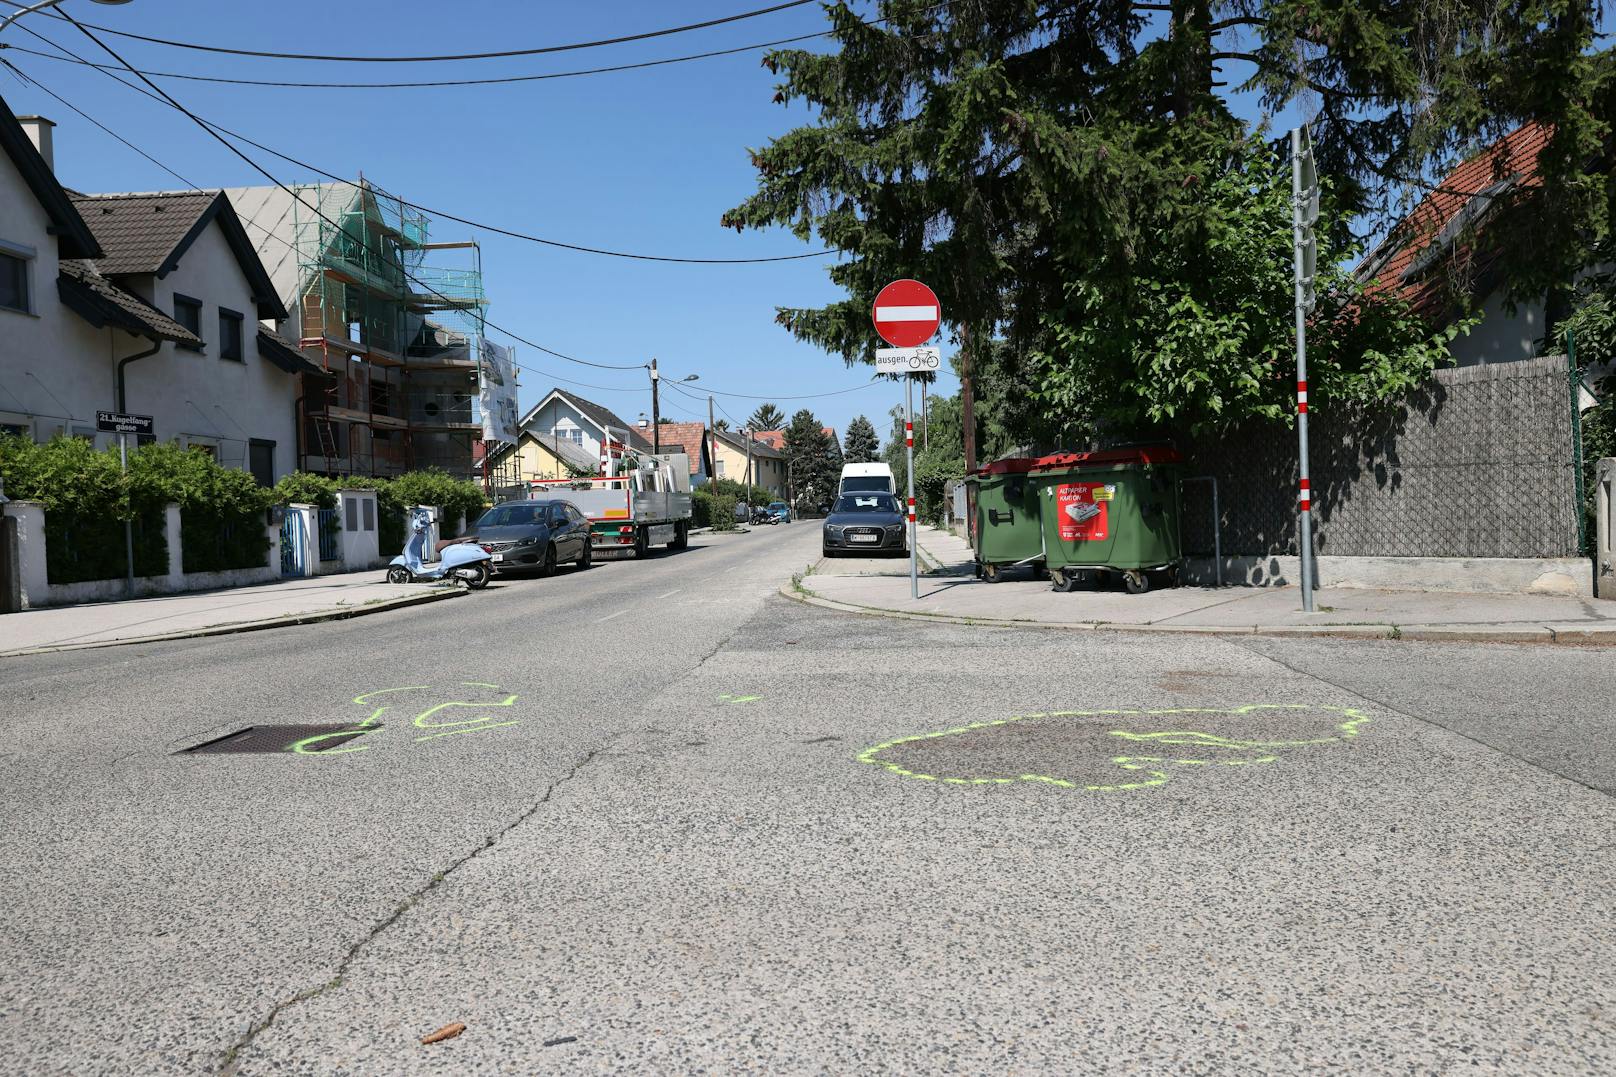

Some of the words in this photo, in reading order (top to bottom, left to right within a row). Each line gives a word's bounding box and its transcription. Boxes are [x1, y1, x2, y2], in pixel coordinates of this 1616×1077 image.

[877, 355, 908, 366] ausgen.
[115, 424, 137, 432] gasse
[1059, 486, 1088, 495] ALTPAPIER
